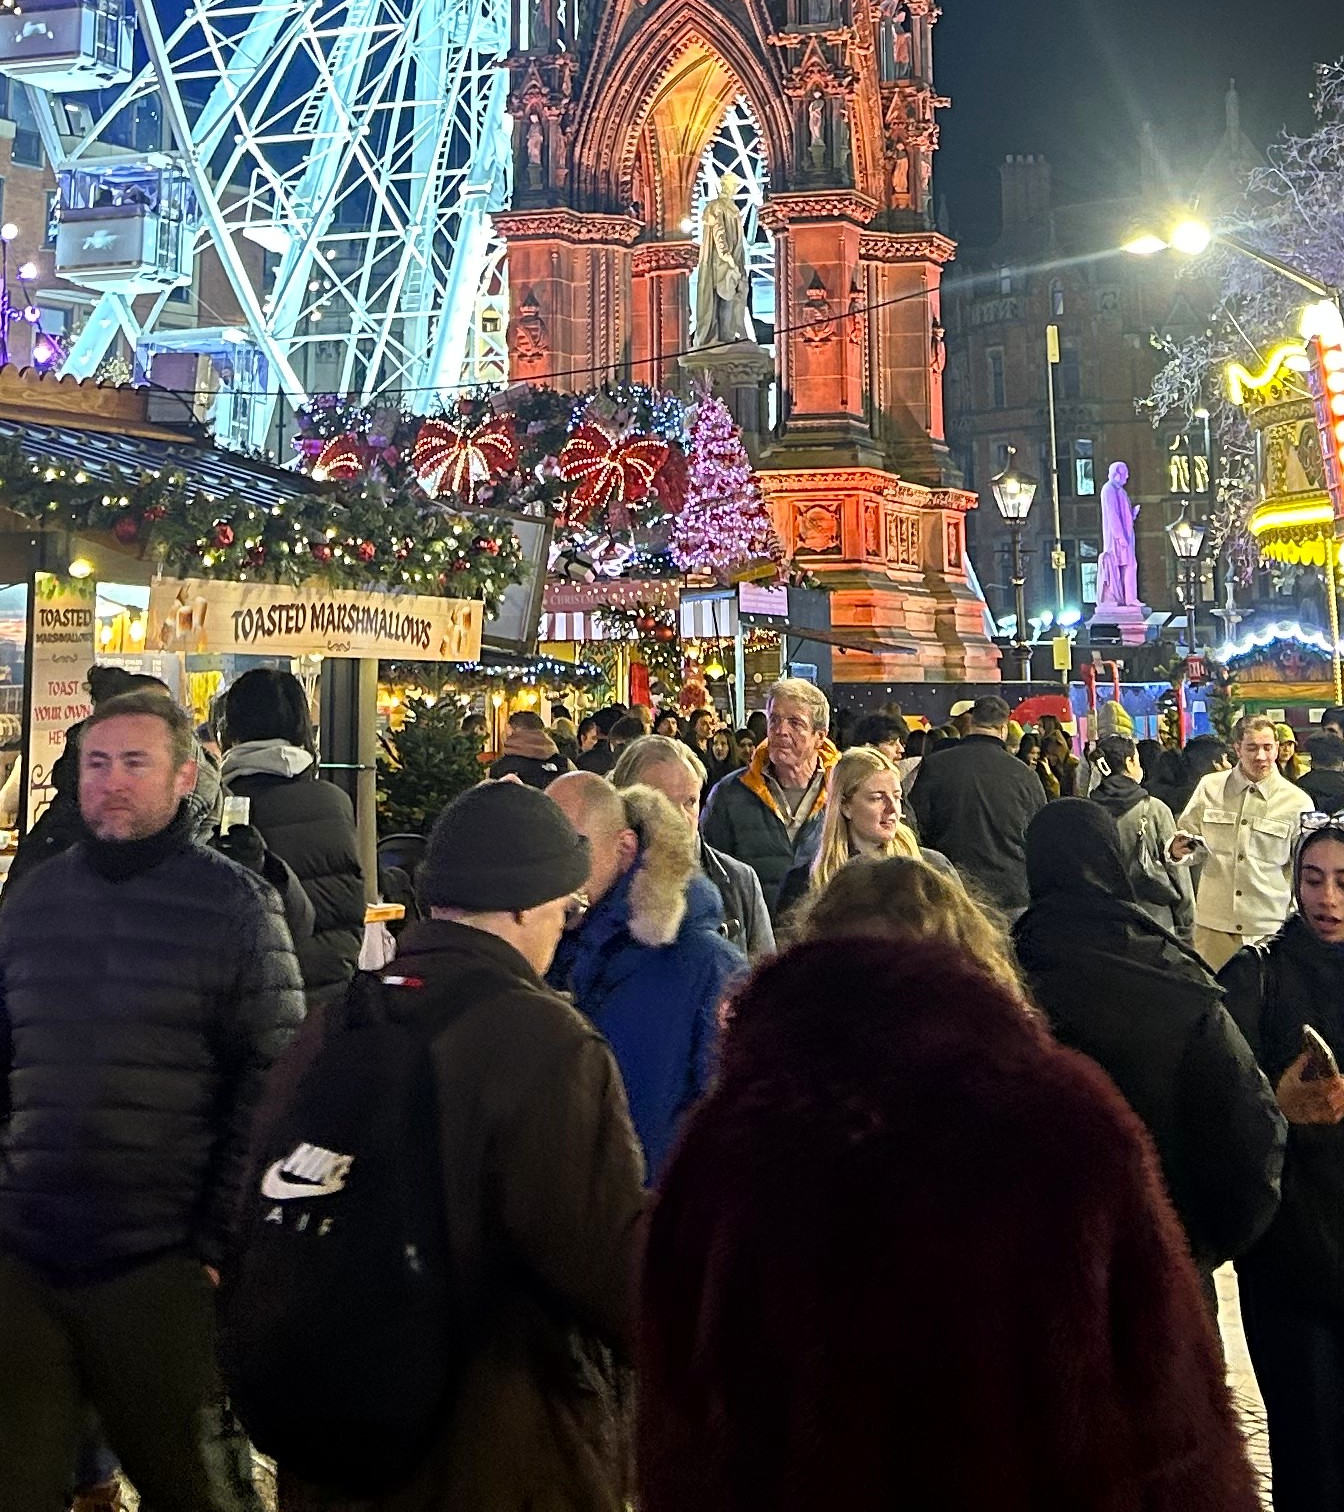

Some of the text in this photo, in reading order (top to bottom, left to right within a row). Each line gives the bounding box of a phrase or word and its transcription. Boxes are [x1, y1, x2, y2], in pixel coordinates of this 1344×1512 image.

[550, 594, 607, 606] CHRISTMAS
[39, 609, 92, 629] TOASTED
[231, 602, 432, 650] TOASTED MARSHMALLOWS
[48, 681, 79, 696] TOAST
[34, 704, 91, 722] YOUR OWN
[48, 730, 67, 746] HE
